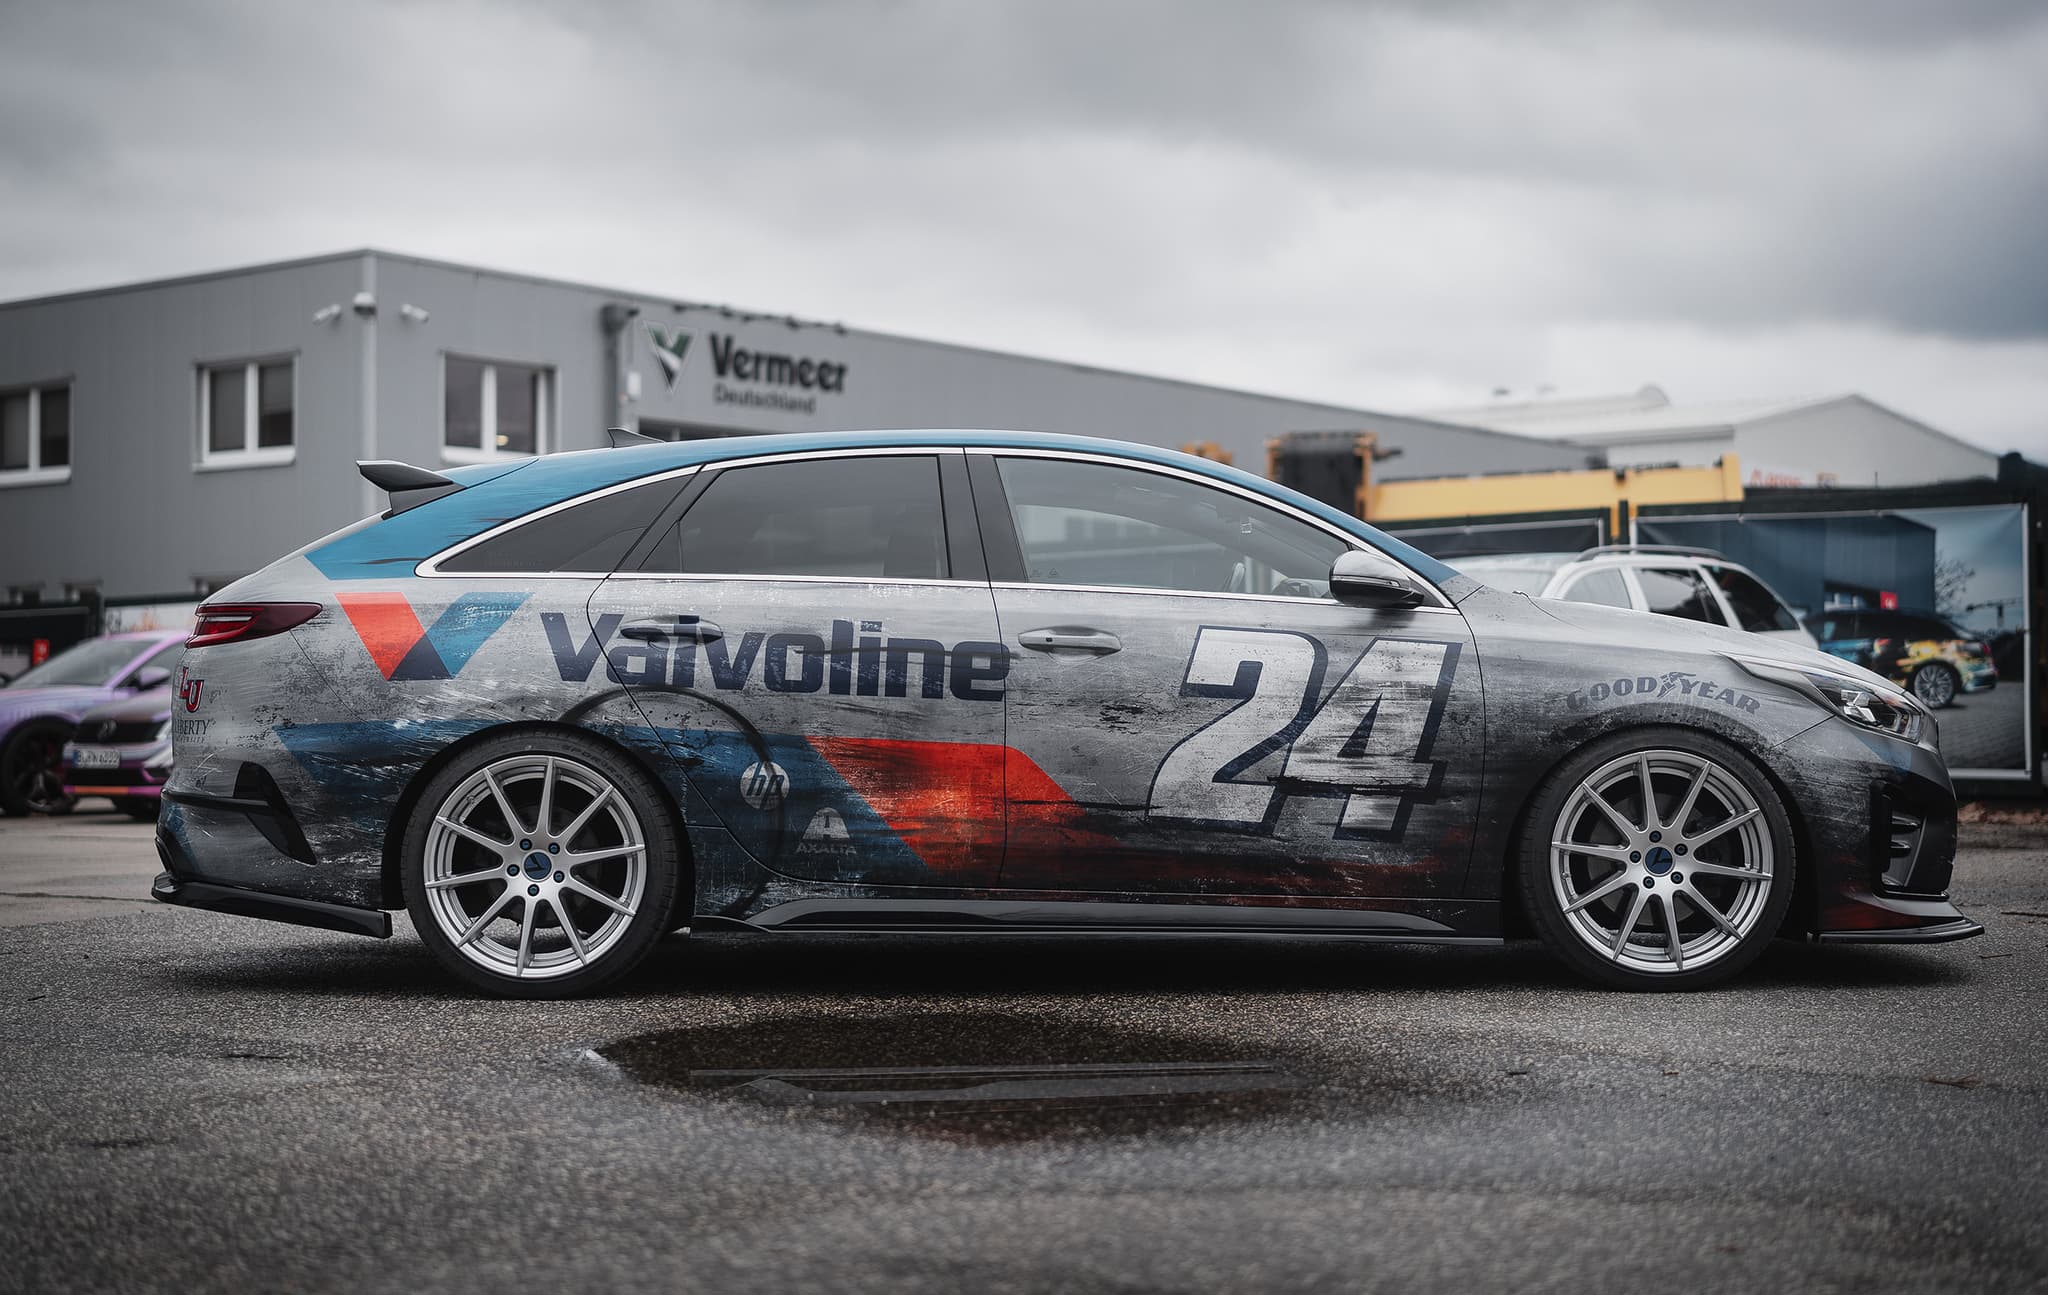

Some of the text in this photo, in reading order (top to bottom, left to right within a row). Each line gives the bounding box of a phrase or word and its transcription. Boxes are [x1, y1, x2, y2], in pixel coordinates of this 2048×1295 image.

[711, 333, 848, 392] Vermeer
[540, 613, 1010, 700] Valvoline
[1567, 675, 1761, 714] GOODYEAR
[1147, 625, 1463, 841] 24
[746, 760, 785, 810] hp
